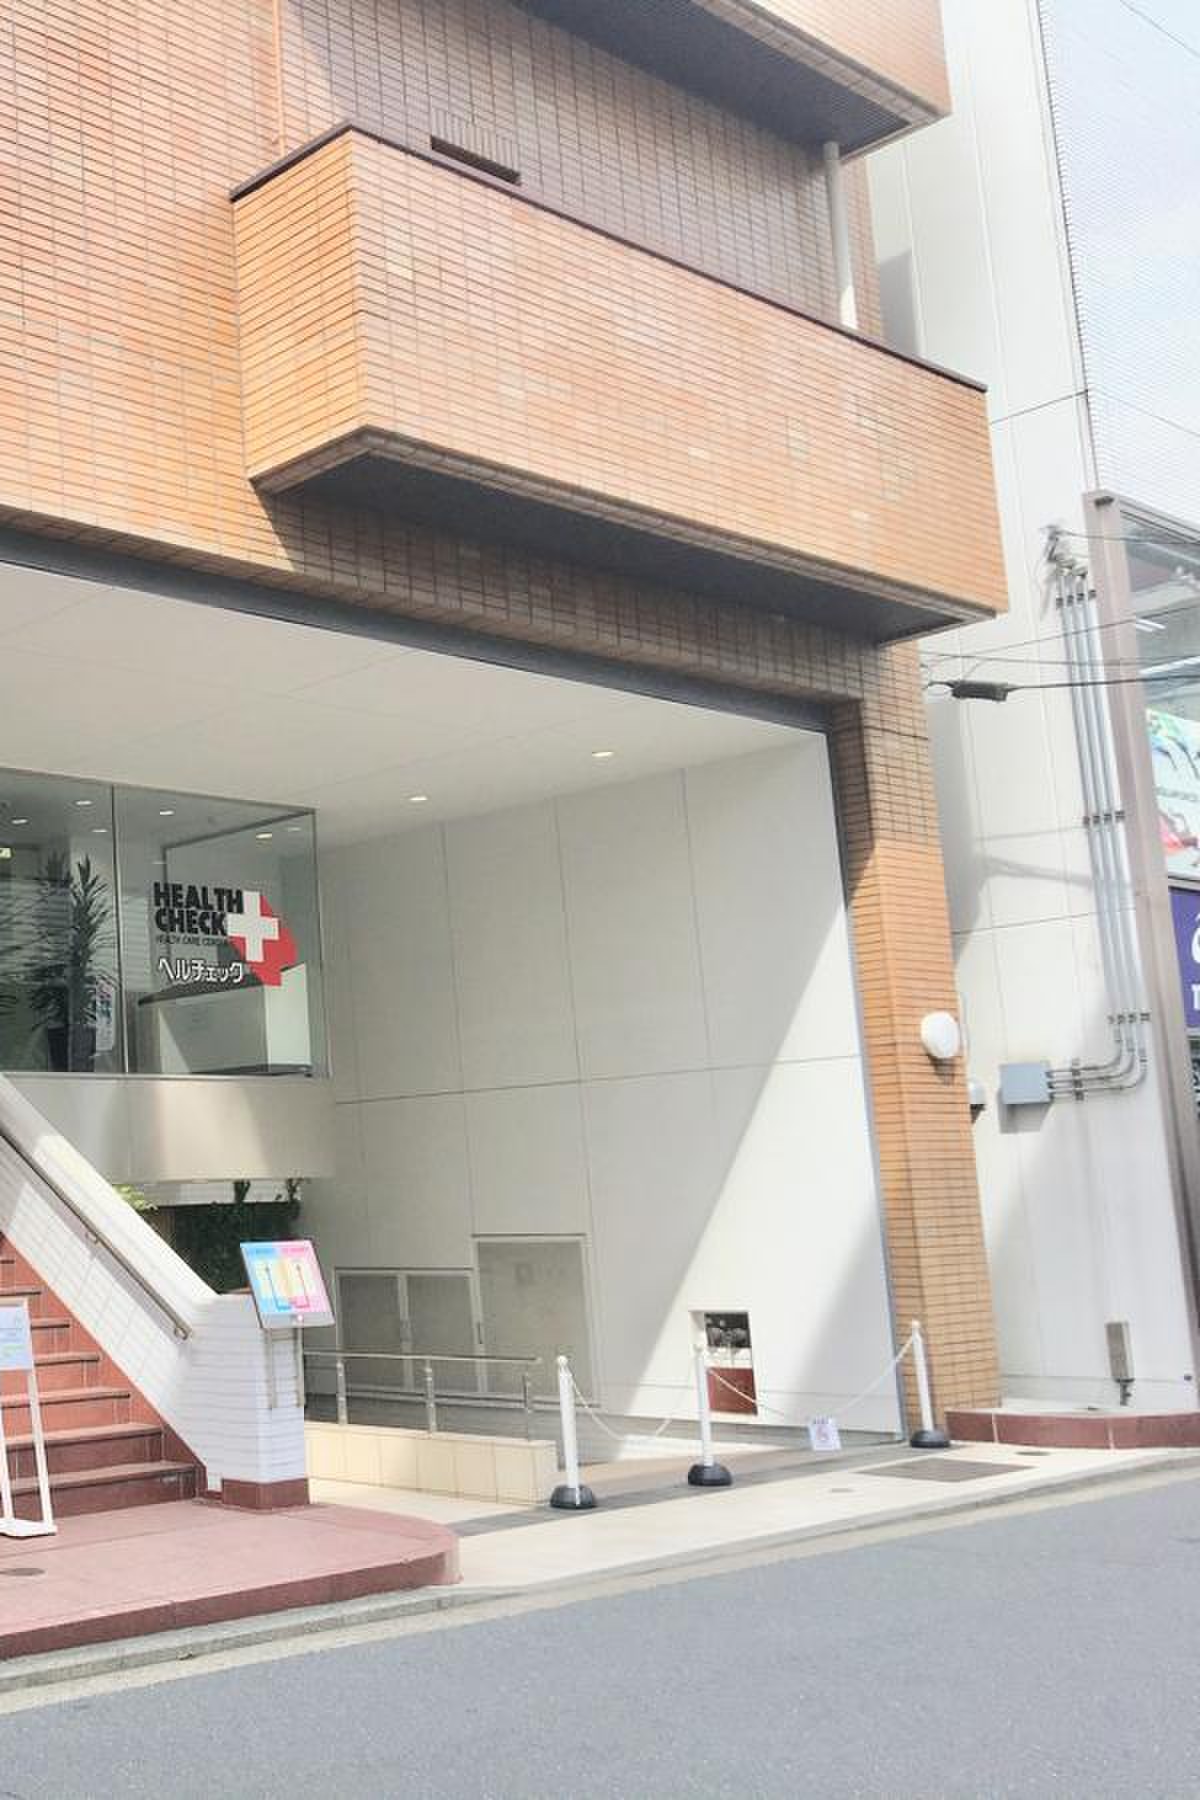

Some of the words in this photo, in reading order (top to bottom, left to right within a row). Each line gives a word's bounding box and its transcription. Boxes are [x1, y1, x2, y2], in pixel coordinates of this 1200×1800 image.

[154, 882, 243, 913] HEALTH
[155, 908, 228, 936] CHECK
[158, 957, 243, 984] ヘルチェック
